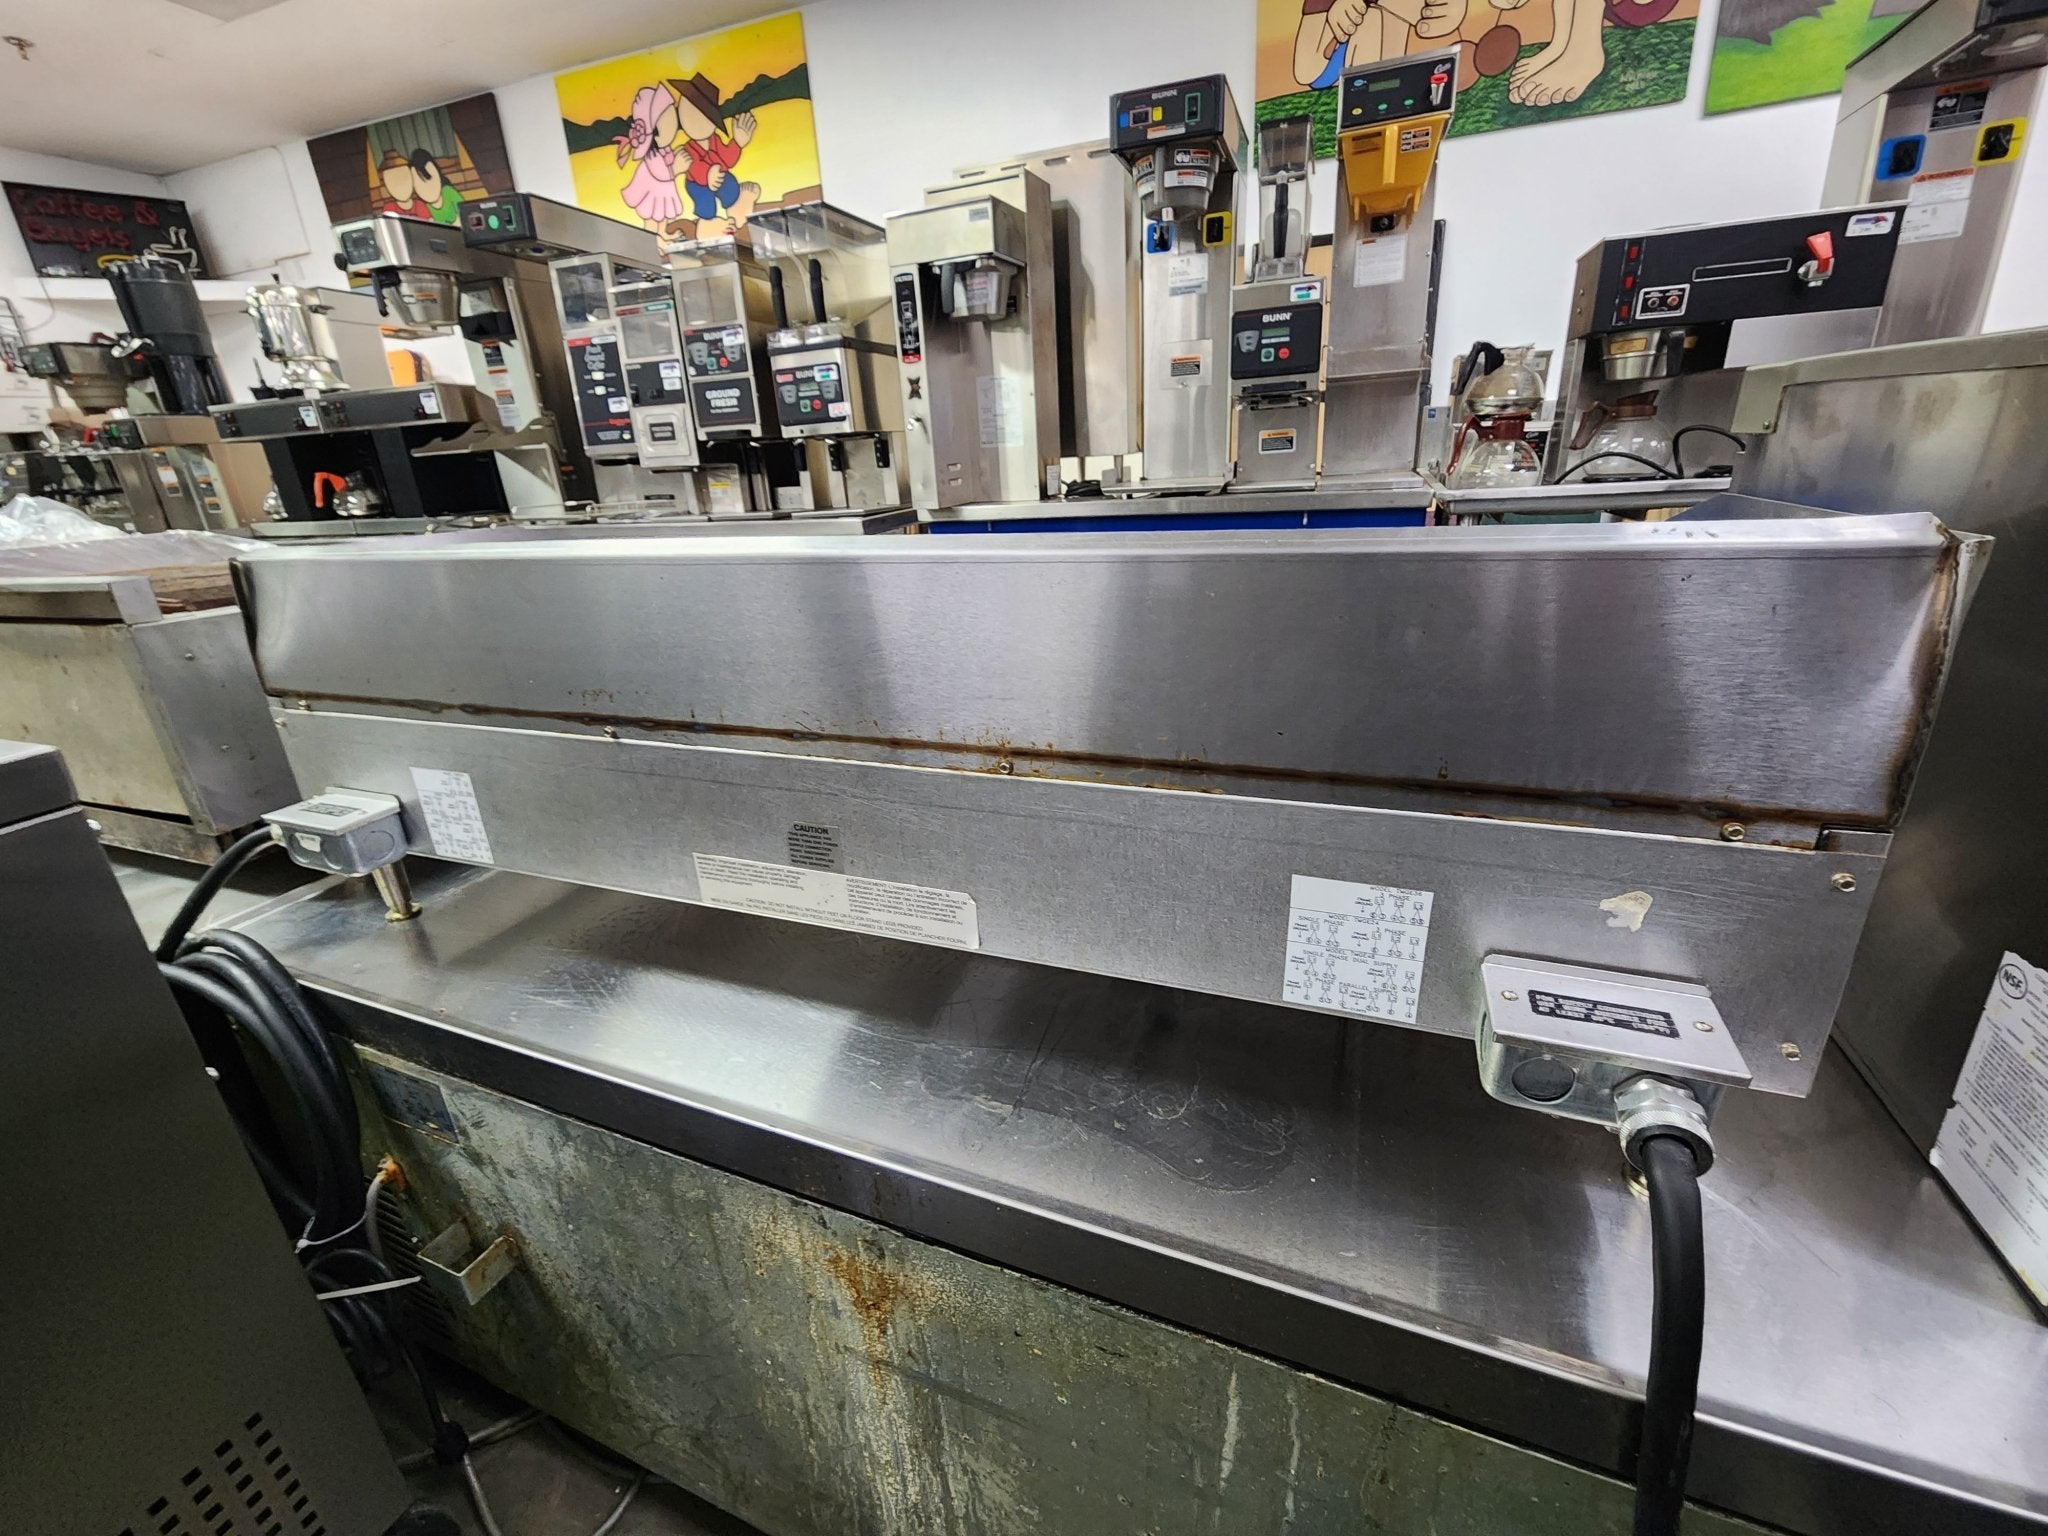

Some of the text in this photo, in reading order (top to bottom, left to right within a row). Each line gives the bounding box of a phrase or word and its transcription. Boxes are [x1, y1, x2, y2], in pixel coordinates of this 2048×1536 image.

[1262, 312, 1292, 323] BUNN
[793, 823, 829, 835] CAUTION
[2002, 968, 2023, 990] NSF
